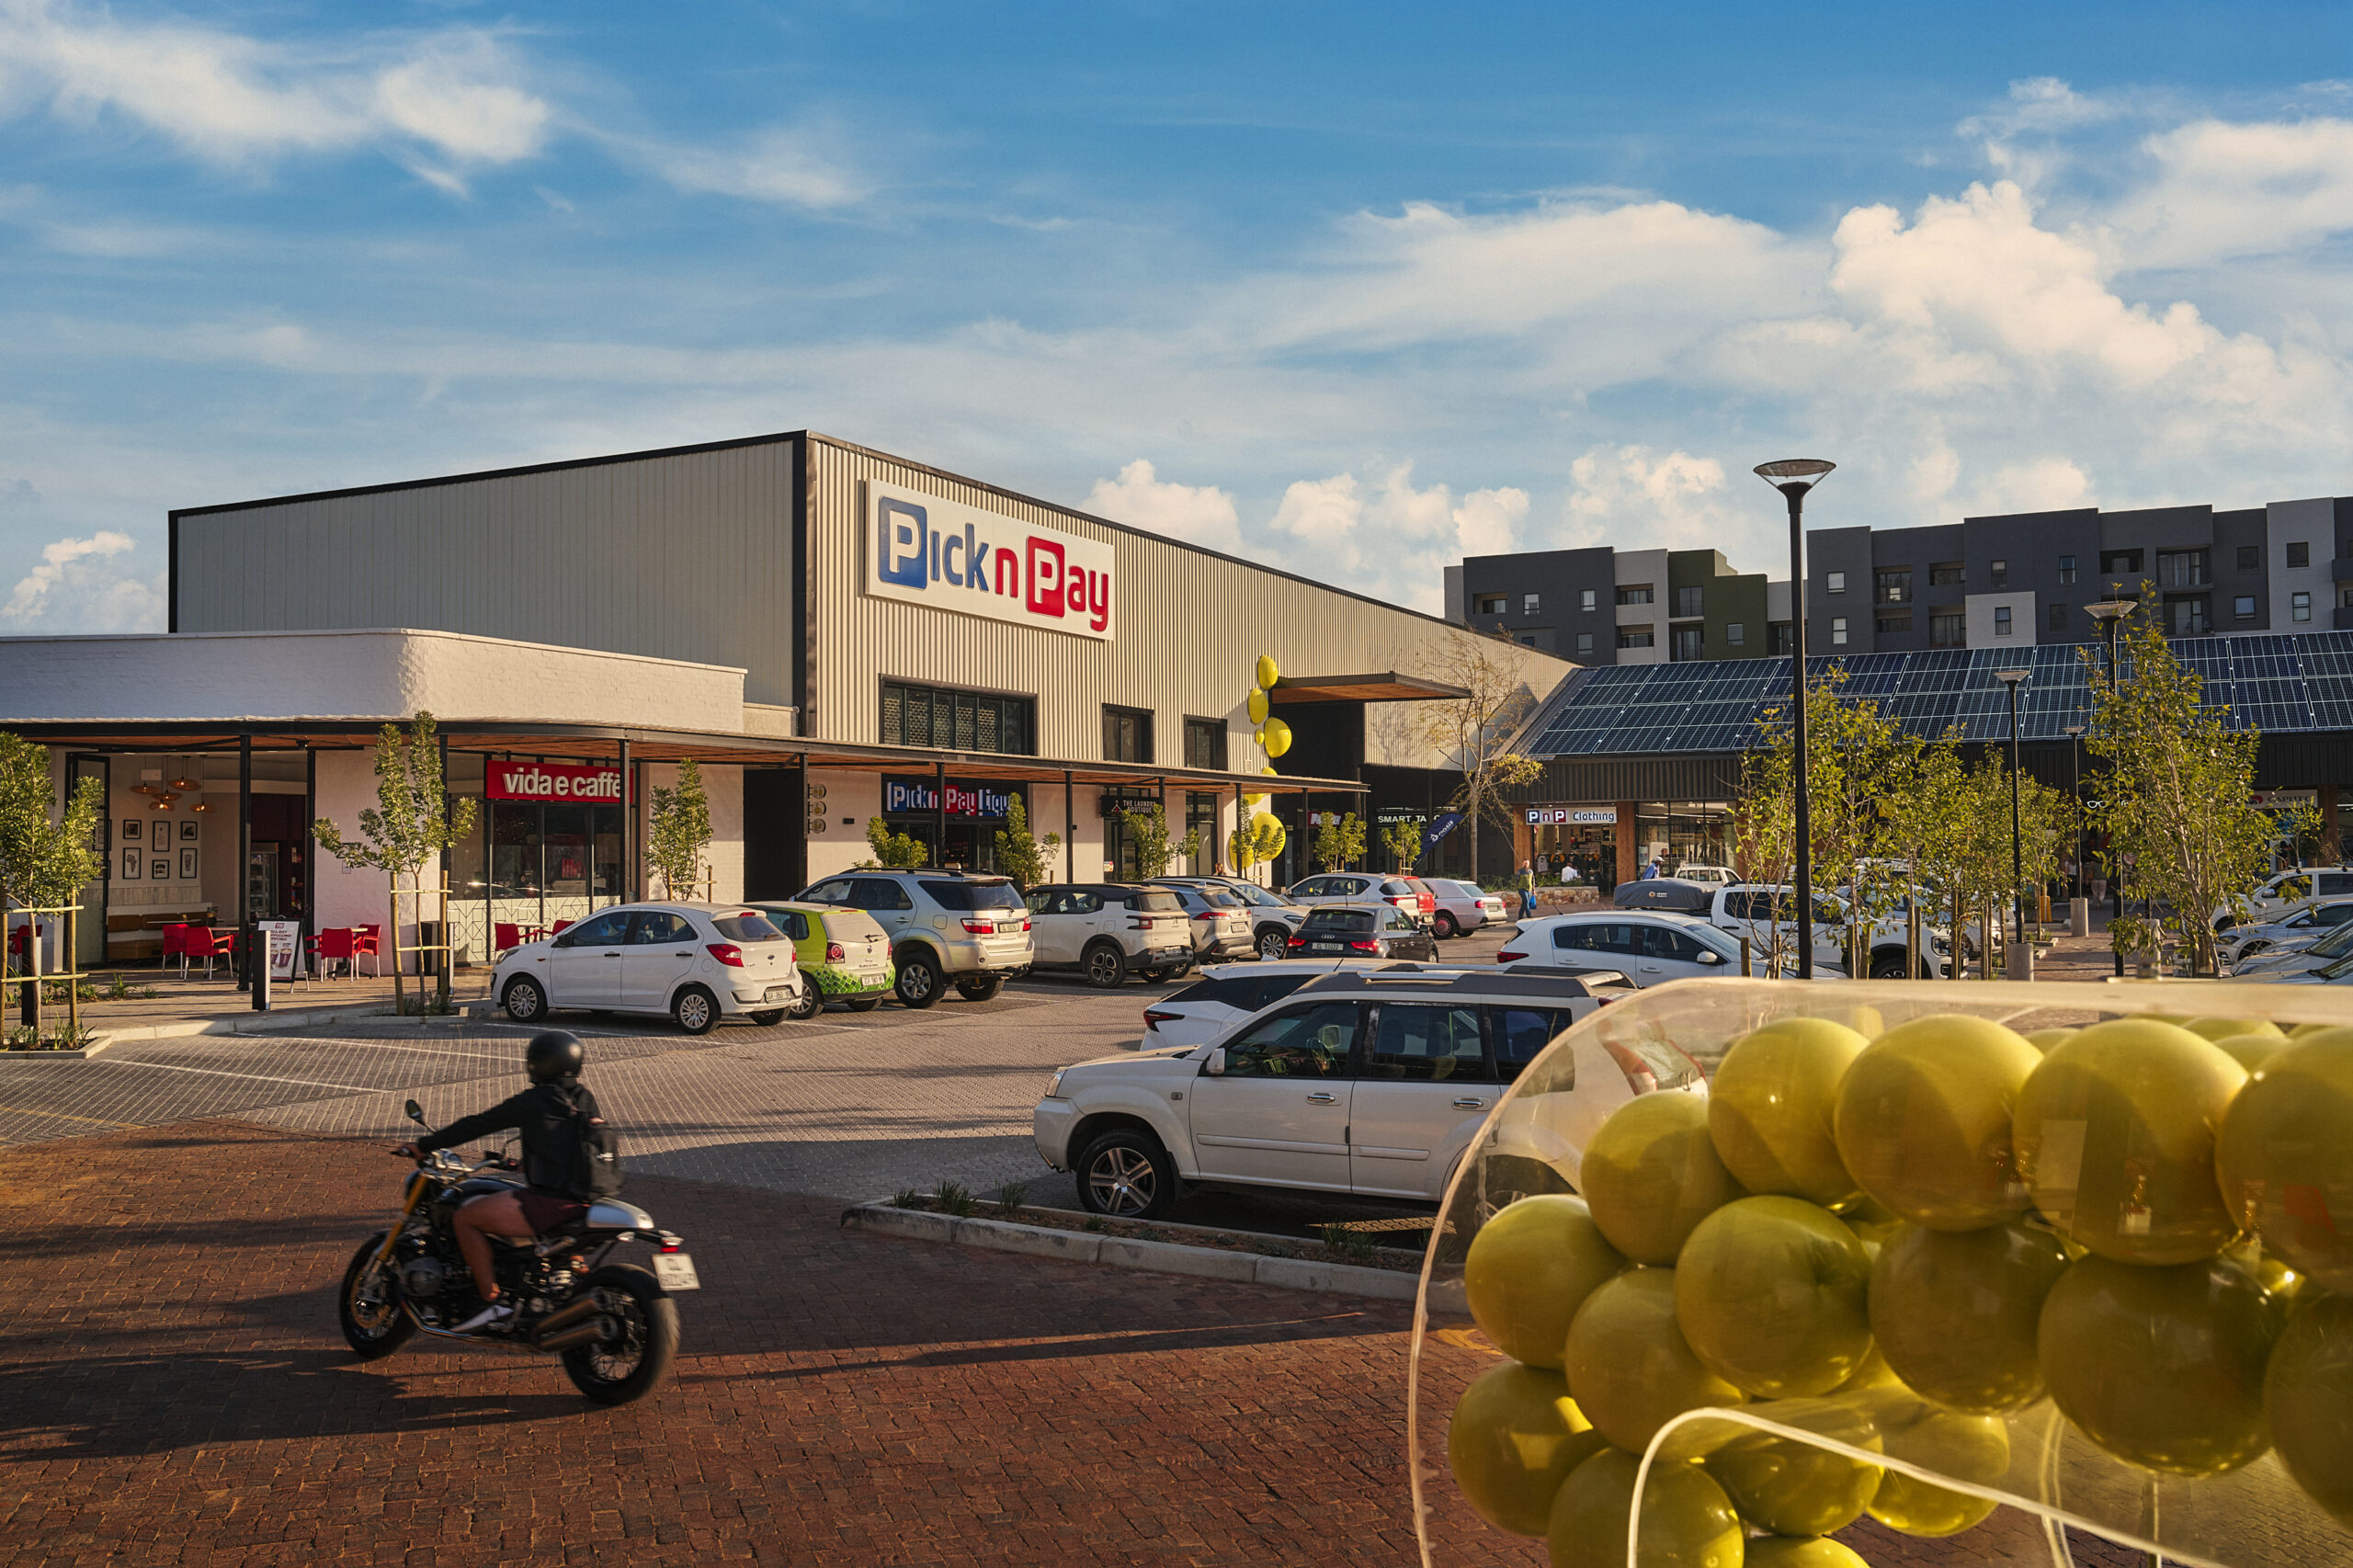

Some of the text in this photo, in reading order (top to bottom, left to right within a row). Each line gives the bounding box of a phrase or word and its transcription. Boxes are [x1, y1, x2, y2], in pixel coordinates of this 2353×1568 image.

[879, 496, 1108, 631] Pick n Pay
[504, 767, 552, 794] vida
[553, 776, 569, 796] e
[887, 782, 926, 812] Pick
[945, 785, 977, 816] Pay
[1378, 815, 1412, 824] SMART
[1573, 811, 1615, 823] Clothing
